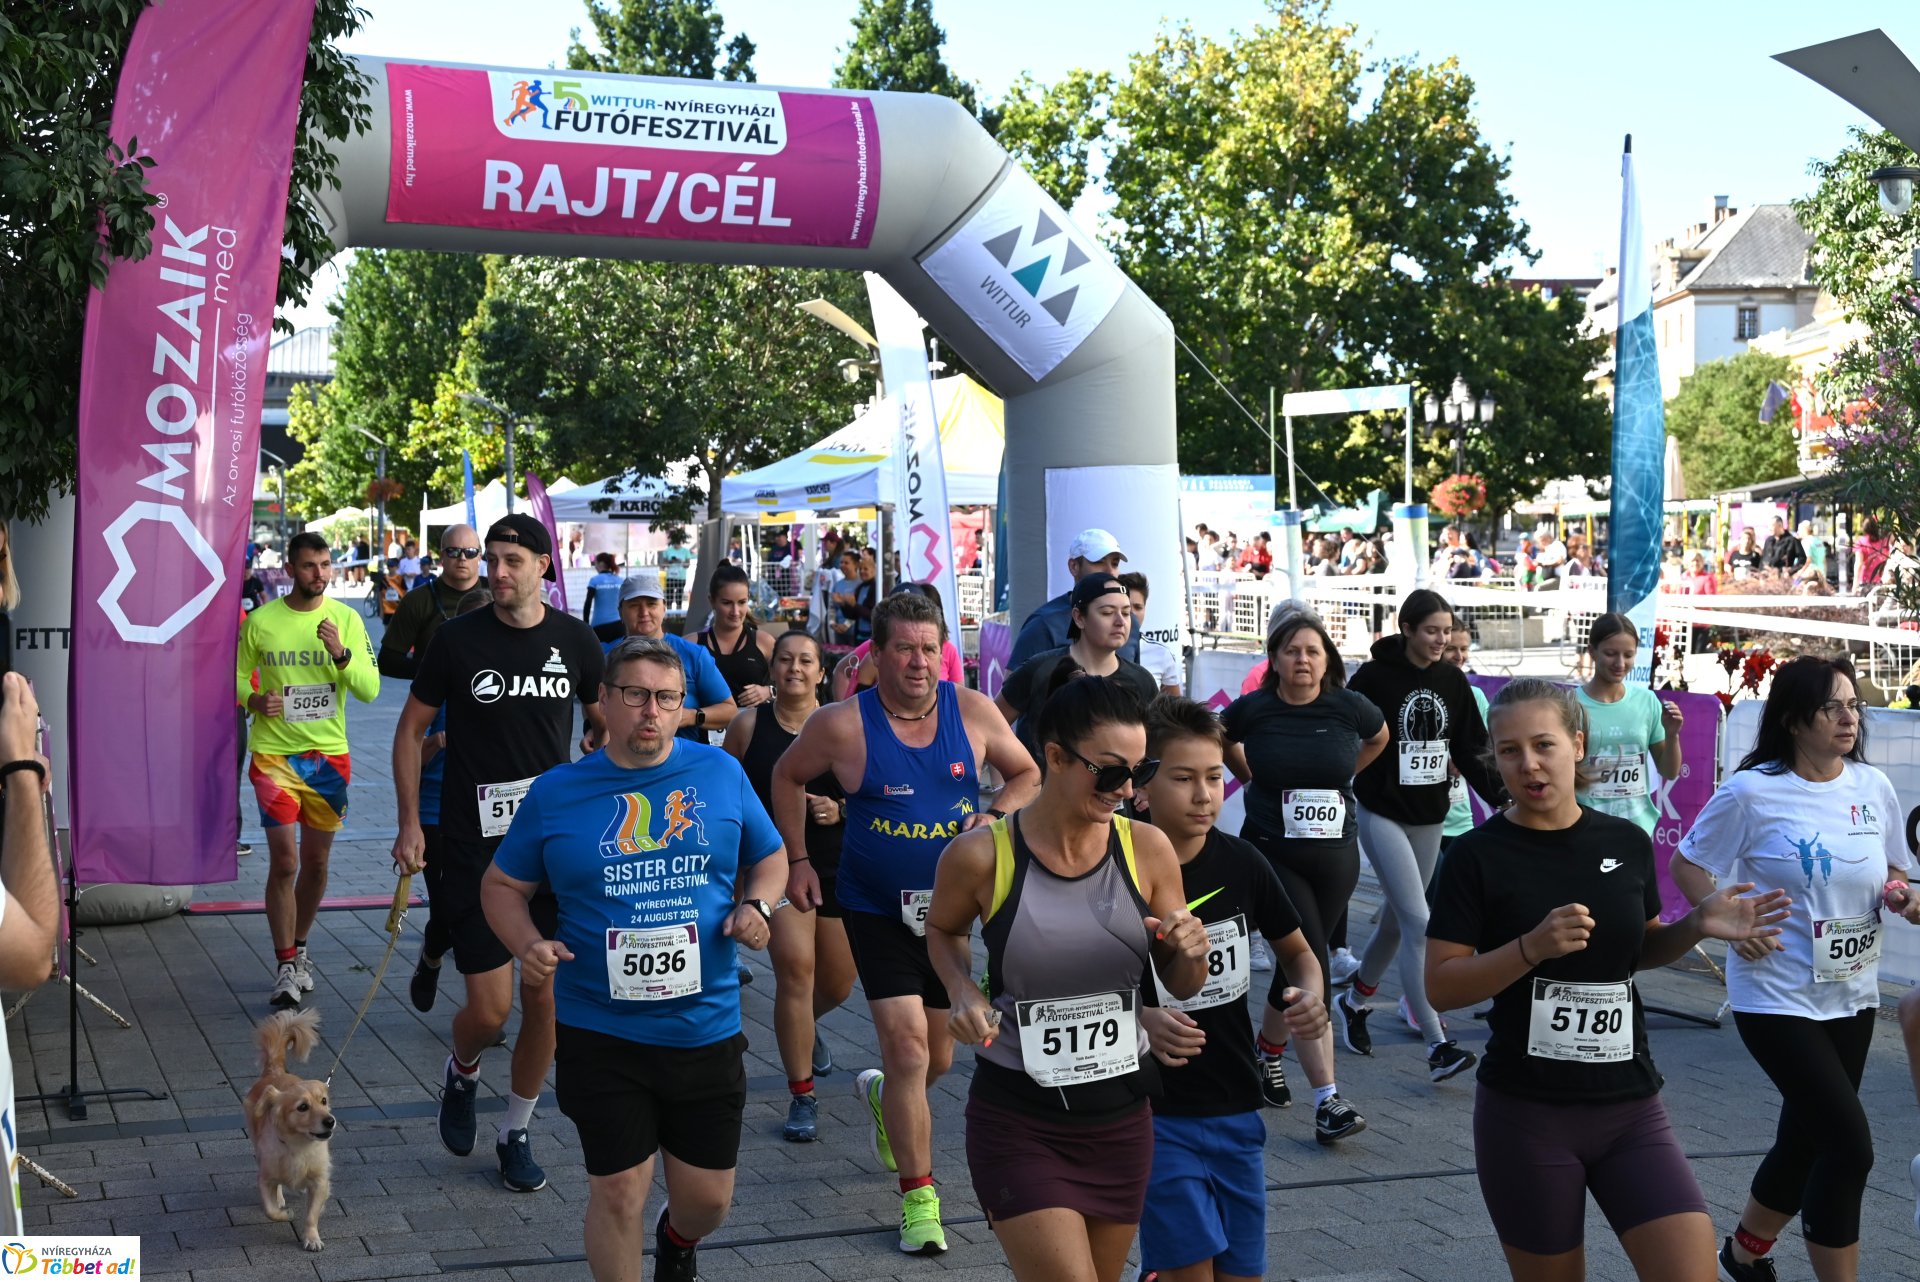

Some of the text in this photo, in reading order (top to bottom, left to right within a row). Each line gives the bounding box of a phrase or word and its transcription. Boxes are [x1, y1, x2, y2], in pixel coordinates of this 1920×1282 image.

[591, 94, 775, 117] WITTUR-NYÍREGYHÁZI
[404, 89, 416, 187] www.mozaikmed.hu
[554, 109, 779, 145] FUTÓFESZTIVÁL
[483, 161, 791, 227] RAJT/CÉL
[211, 227, 237, 304] med
[980, 275, 1031, 329] WITTUR
[136, 215, 209, 500] MOZAIK
[222, 313, 253, 507] Az orvosi futóközösség
[620, 499, 662, 512] KÄRC
[259, 650, 332, 666] AMSU
[508, 675, 571, 699] JAKO
[293, 695, 329, 710] 5056
[1410, 755, 1444, 770] 5187
[1600, 768, 1639, 784] 5106
[492, 797, 524, 818] 51
[1293, 806, 1337, 821] 5060
[603, 854, 711, 883] SISTER CITY
[1602, 858, 1617, 867] NIKE
[605, 873, 709, 897] RUNNING FESTIVAL
[635, 896, 693, 911] NYÍREGYHÁZA
[630, 909, 700, 924] 24 AUGUST 2025
[1829, 930, 1877, 960] 5085
[623, 949, 686, 976] 5036
[1208, 945, 1236, 976] 81
[1561, 995, 1615, 1004] FUTÓFESZTIVÁL
[1047, 1007, 1105, 1022] FUTÓFESZTIVÁL
[1550, 1006, 1623, 1035] 5180
[1042, 1018, 1119, 1056] 5179
